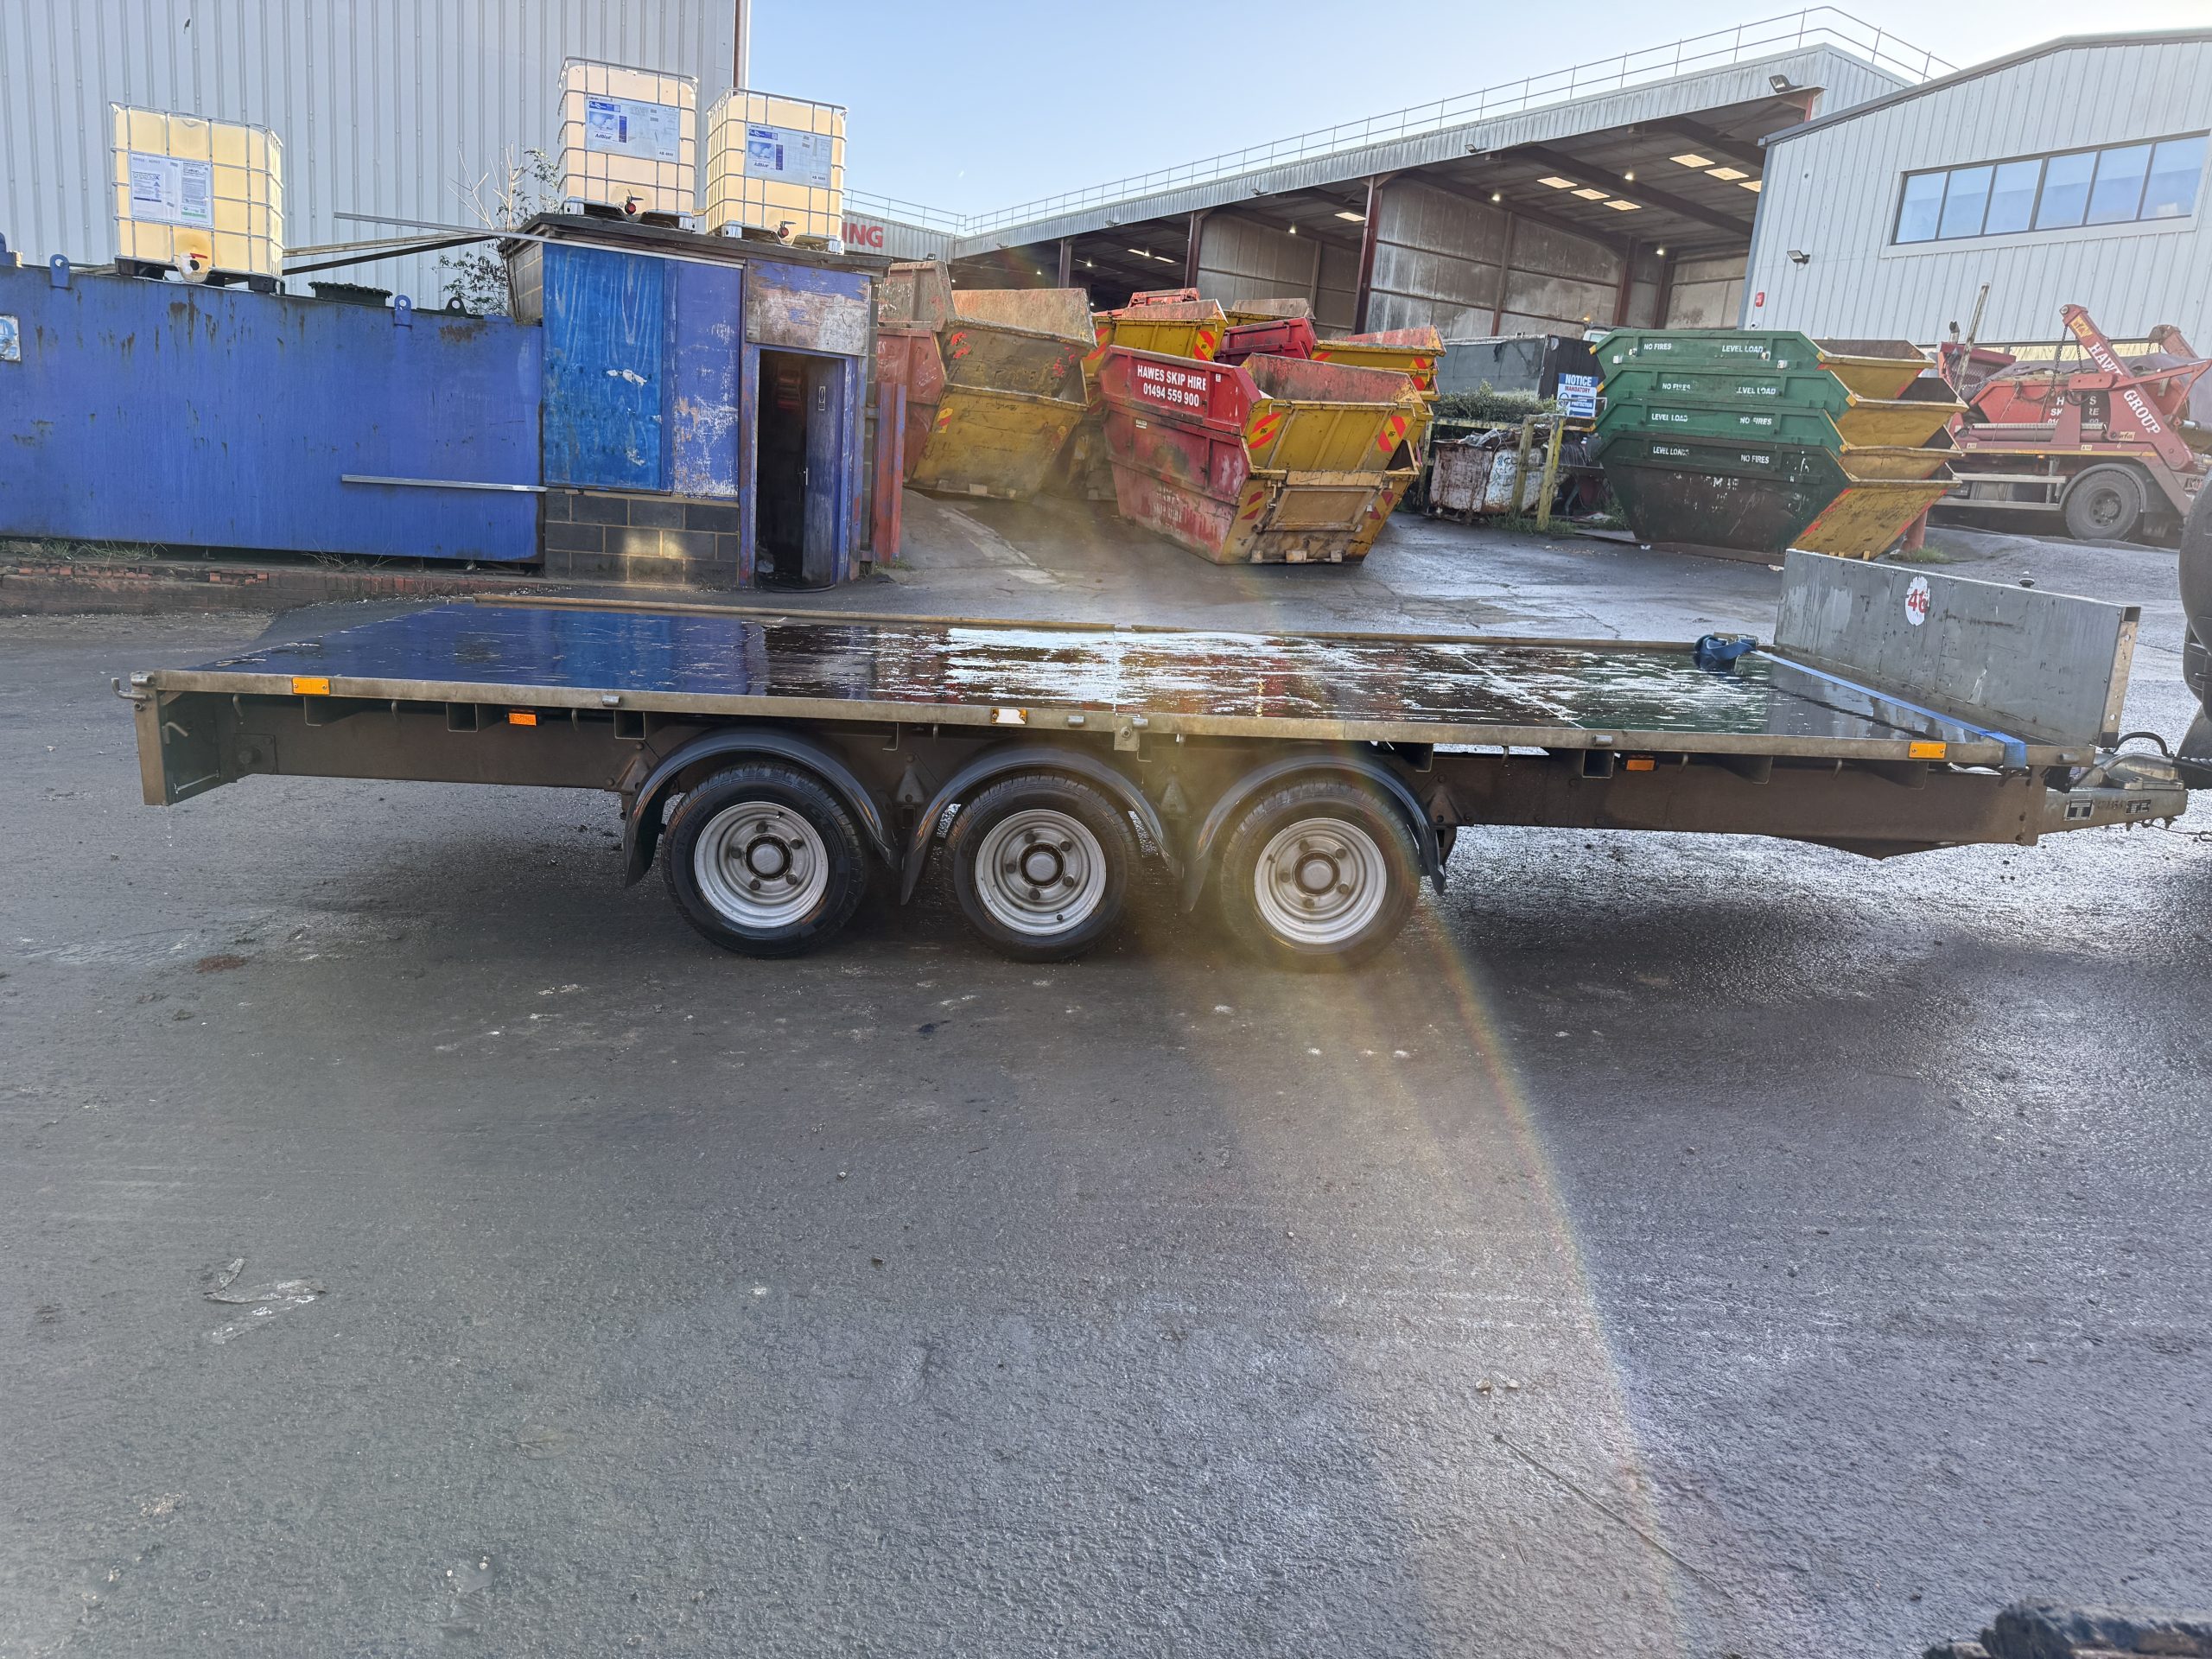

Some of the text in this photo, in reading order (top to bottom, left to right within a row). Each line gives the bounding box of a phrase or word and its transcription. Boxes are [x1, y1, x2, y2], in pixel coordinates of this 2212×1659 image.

[1137, 365, 1206, 391] HAWES SKIP HIRE
[1565, 374, 1592, 386] NOTICE
[1143, 383, 1199, 407] 01494 559 900
[2123, 389, 2161, 435] GROUP
[1653, 446, 1669, 454] LEVEL
[1751, 454, 1770, 464] FIRES
